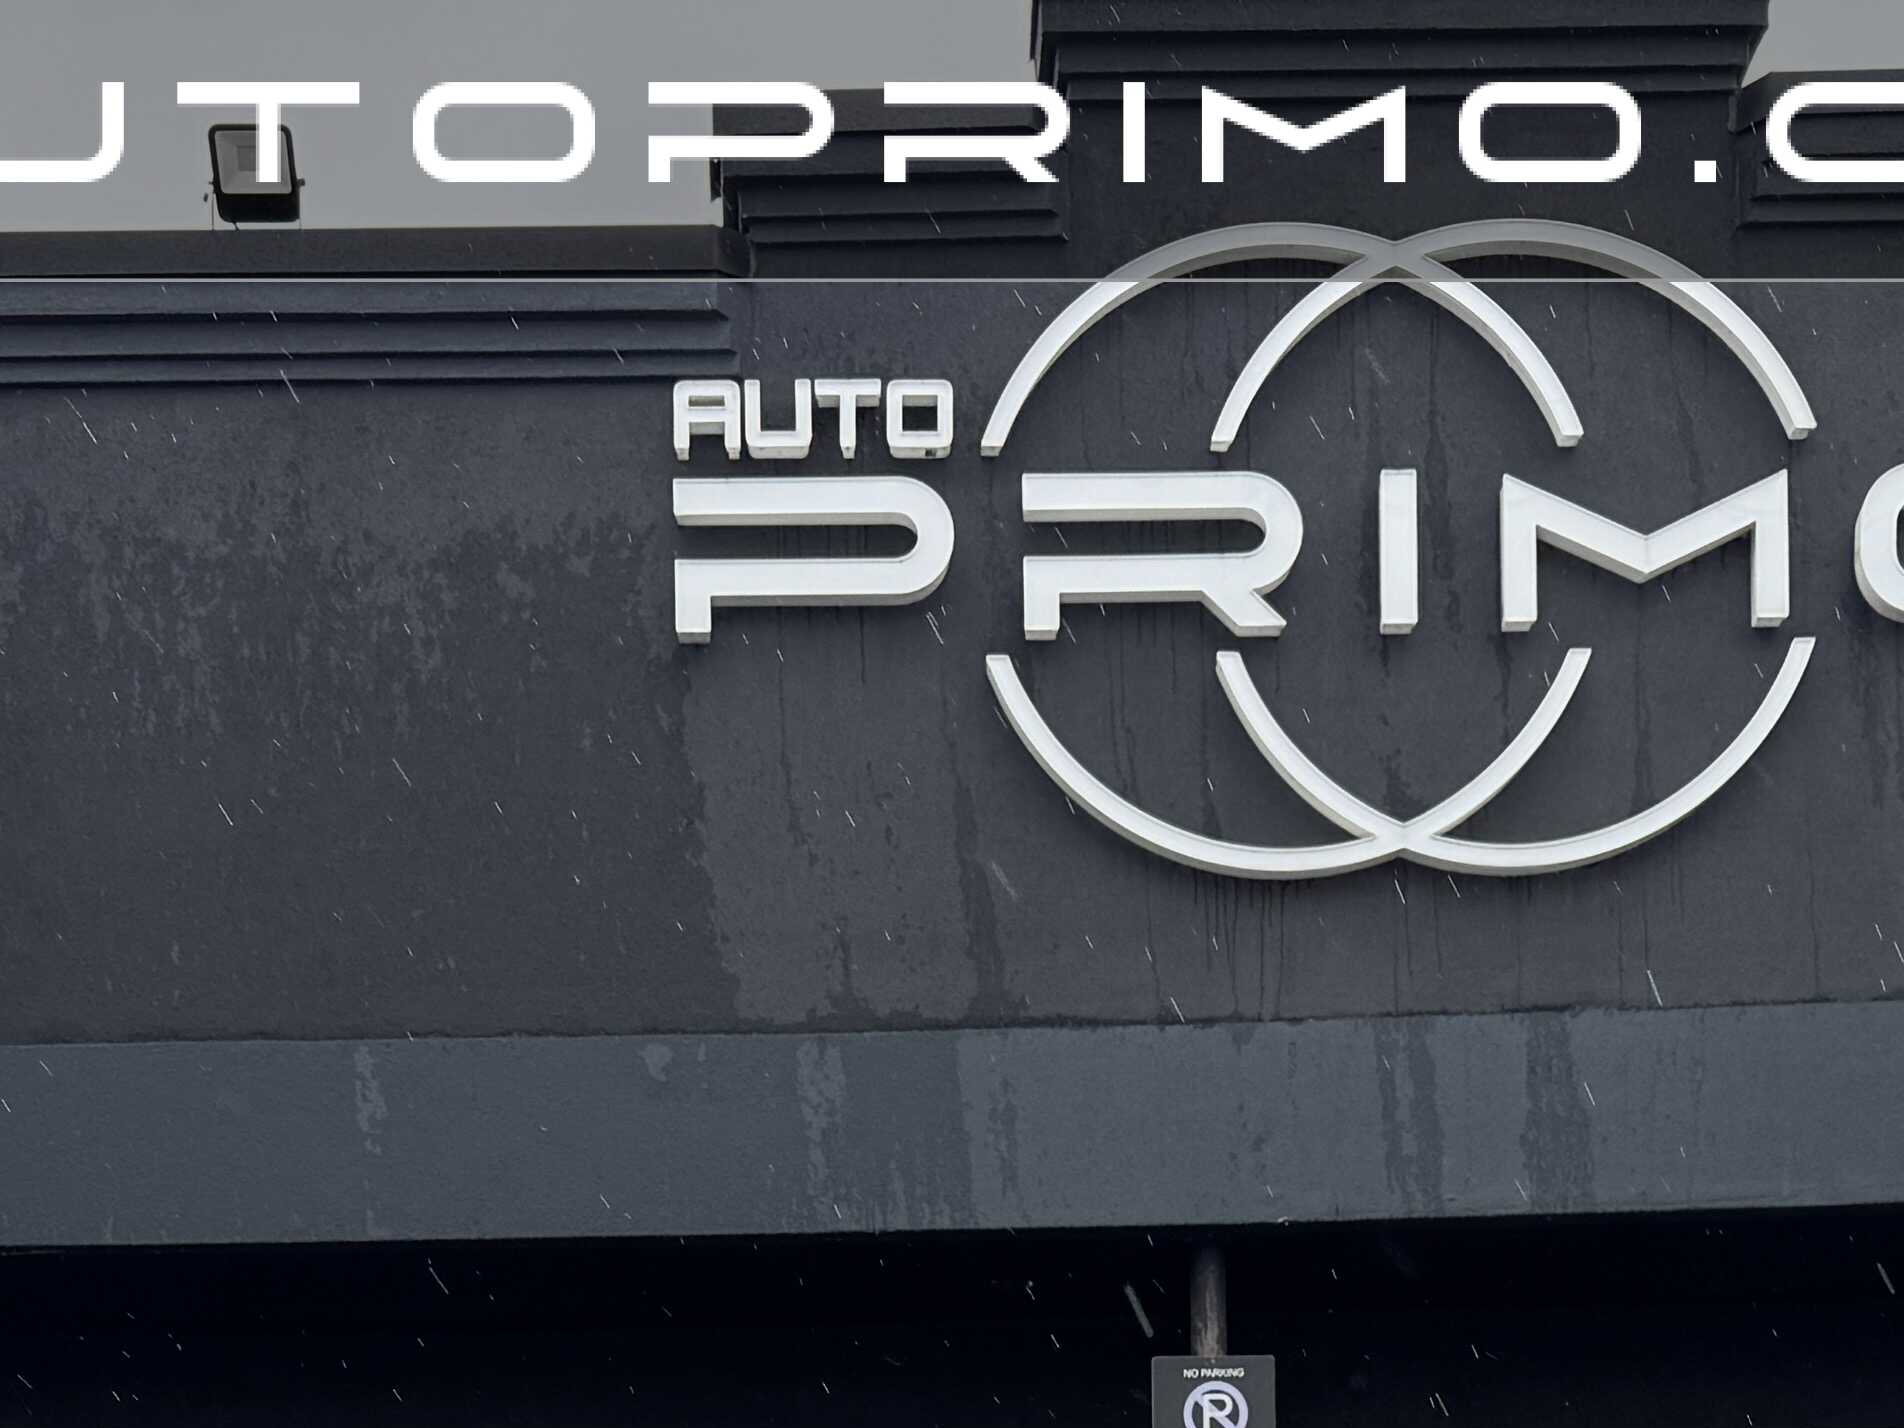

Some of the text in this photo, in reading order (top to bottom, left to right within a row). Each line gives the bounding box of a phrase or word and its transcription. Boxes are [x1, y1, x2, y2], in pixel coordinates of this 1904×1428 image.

[672, 377, 954, 462] AUTO
[1183, 1367, 1245, 1379] NO PARKING
